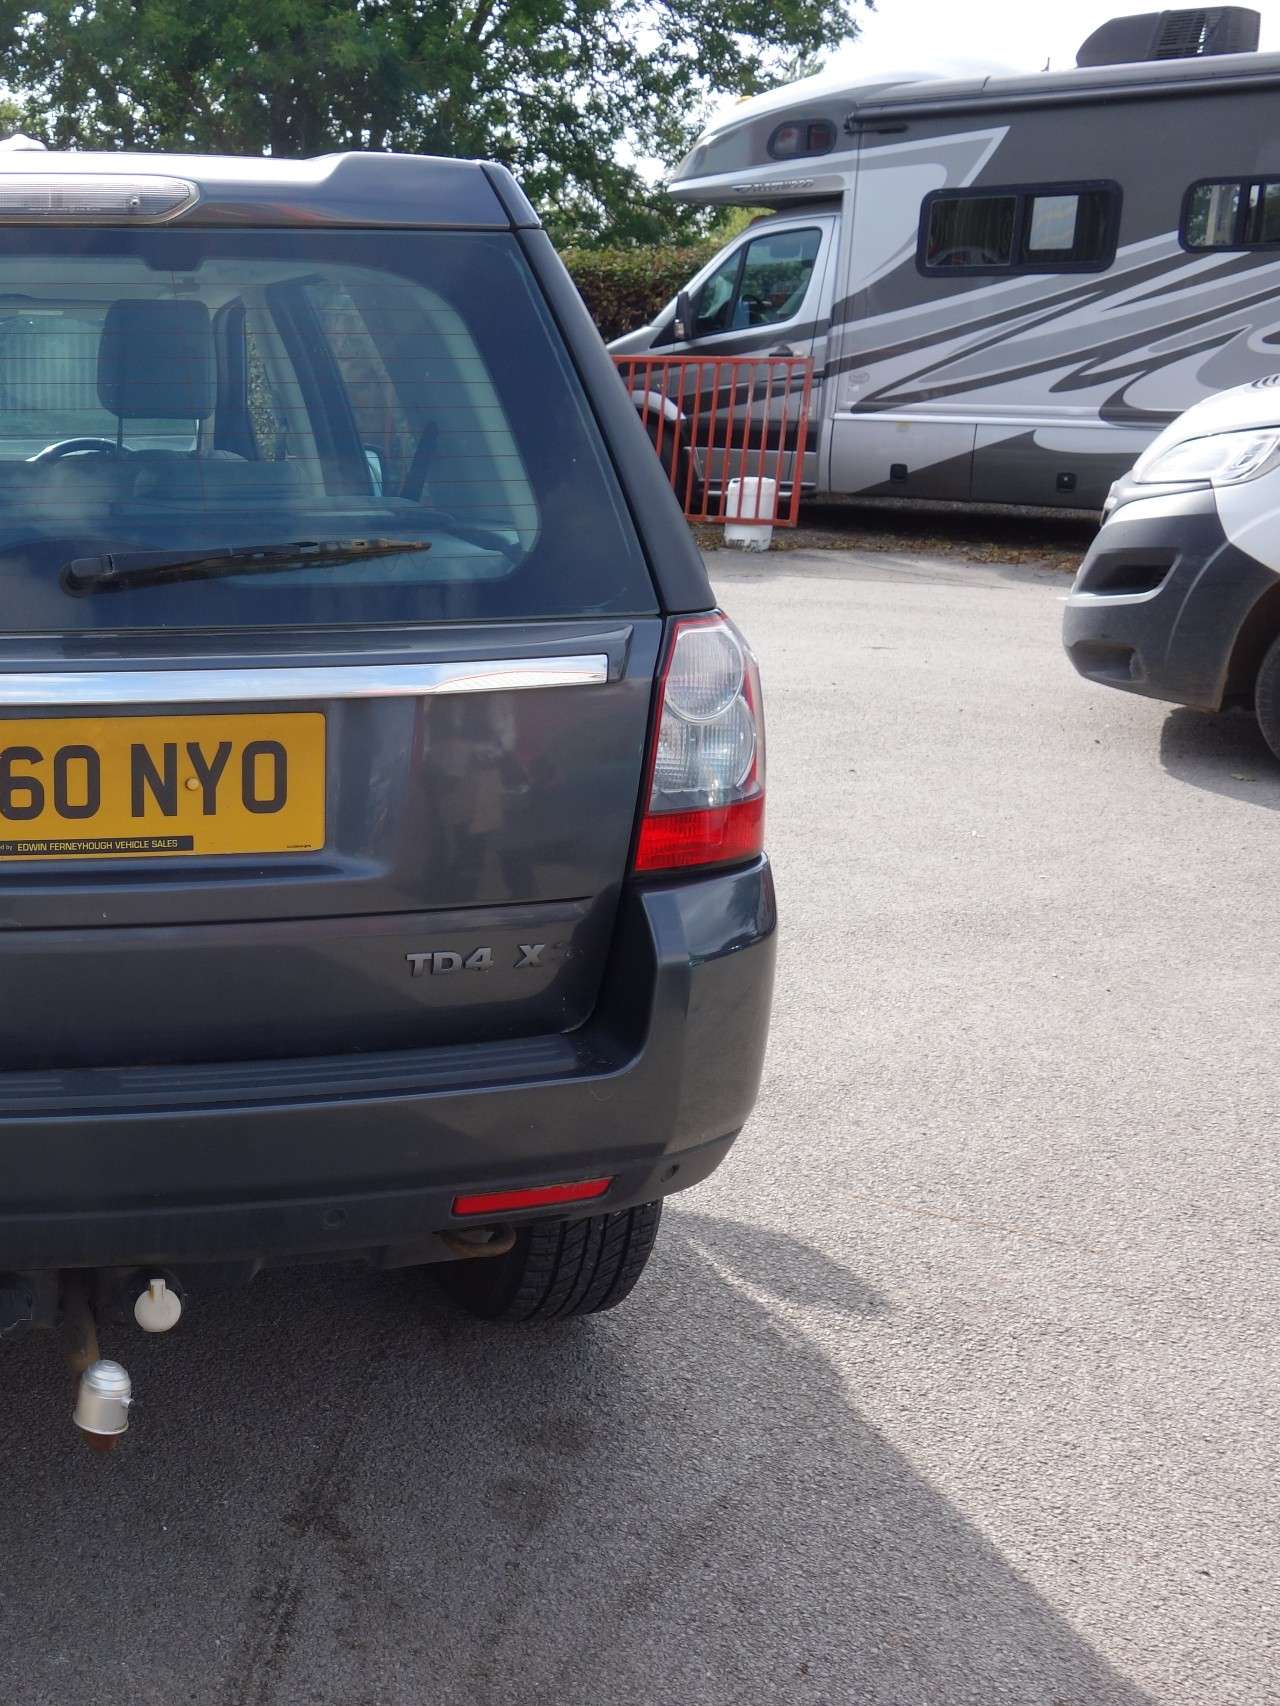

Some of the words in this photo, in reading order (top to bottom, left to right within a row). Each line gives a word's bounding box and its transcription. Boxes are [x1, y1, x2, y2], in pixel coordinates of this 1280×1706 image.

[130, 739, 288, 818] NYO
[6, 843, 13, 852] by
[17, 842, 47, 852] EDWIN
[49, 841, 112, 851] FERNEYHOUGH
[115, 840, 150, 849] VEHICLE
[151, 839, 178, 848] SALES
[405, 947, 495, 977] TD4
[512, 944, 546, 968] X
